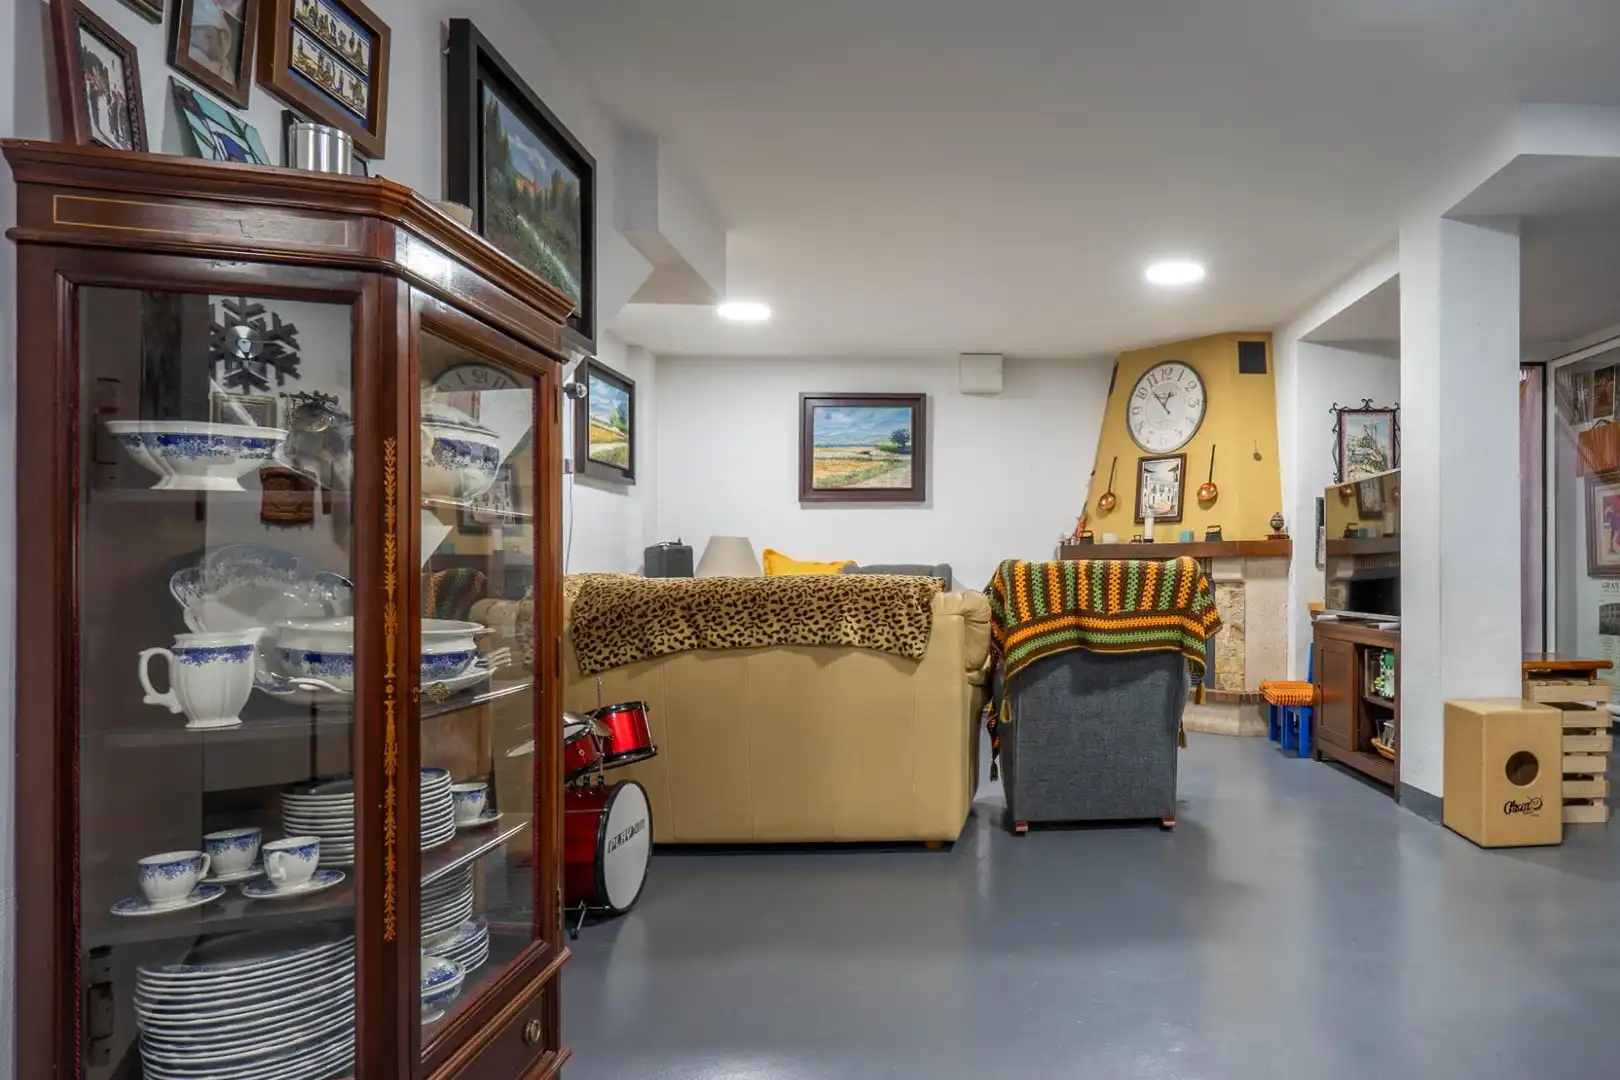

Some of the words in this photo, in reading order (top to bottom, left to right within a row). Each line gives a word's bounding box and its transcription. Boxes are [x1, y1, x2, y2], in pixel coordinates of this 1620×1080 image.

[1146, 372, 1159, 388] 11
[1160, 367, 1174, 381] 12
[1184, 380, 1198, 393] 2
[1135, 387, 1149, 401] 10
[1187, 396, 1201, 409] 3
[1601, 581, 1620, 589] GRAN
